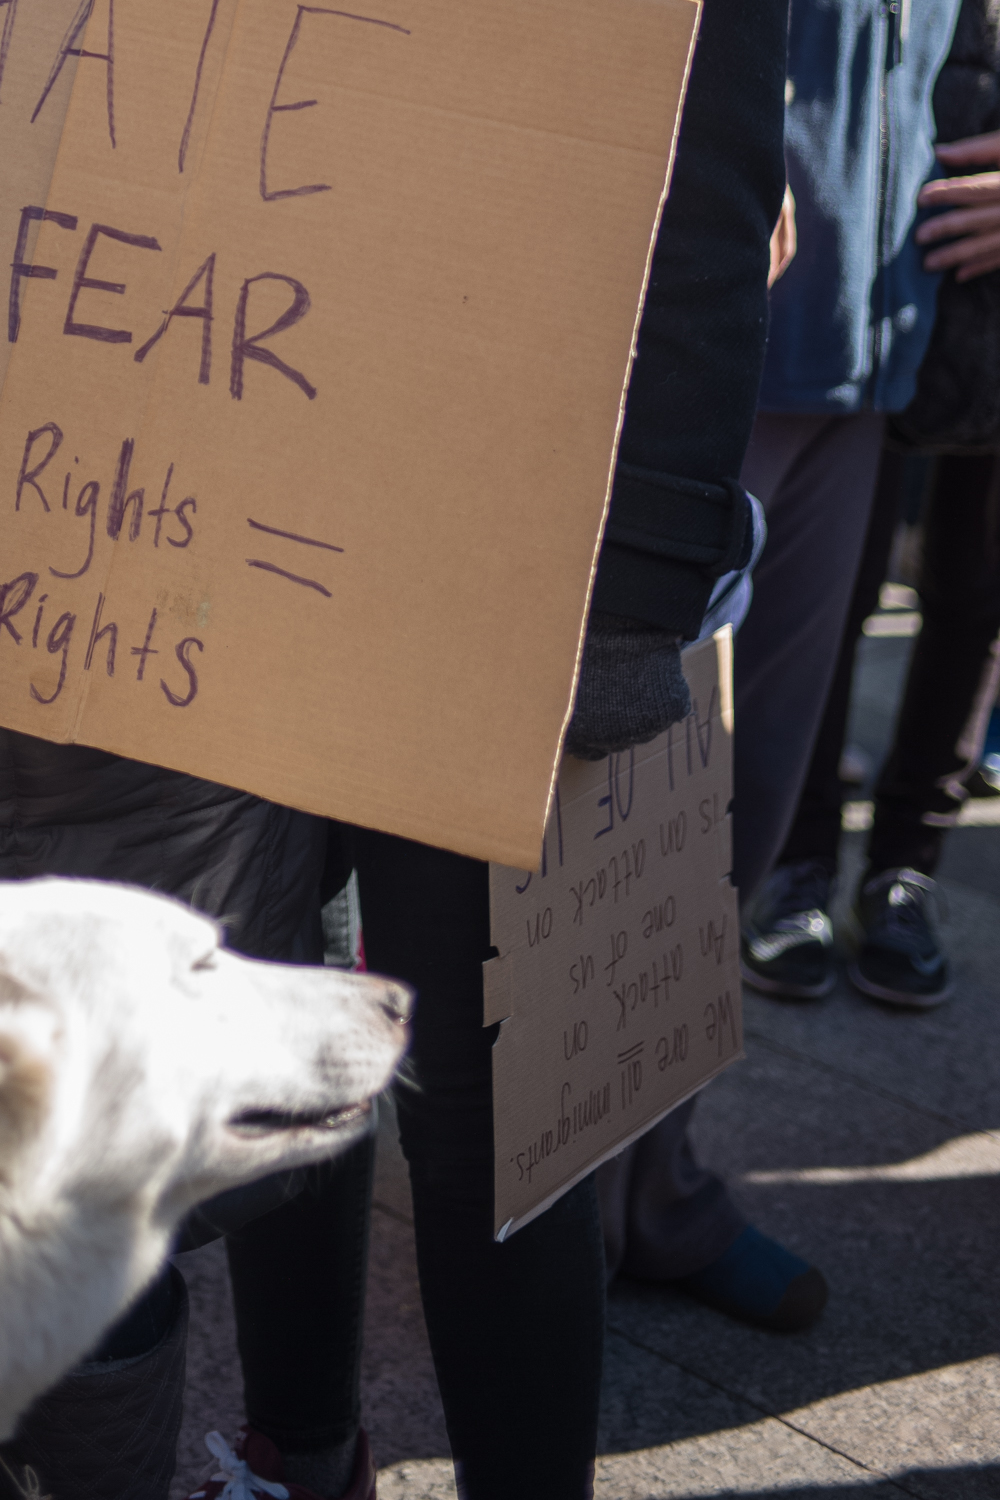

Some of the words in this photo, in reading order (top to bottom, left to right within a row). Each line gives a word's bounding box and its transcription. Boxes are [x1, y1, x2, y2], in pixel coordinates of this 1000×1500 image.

[9, 205, 317, 400] FEAR
[15, 422, 198, 579] Rights
[659, 810, 688, 857] an
[569, 838, 647, 927] attack
[526, 907, 553, 948] on
[641, 895, 677, 939] one
[699, 913, 728, 966] An
[569, 954, 595, 994] us
[604, 930, 628, 987] of
[613, 943, 684, 1032] attack
[563, 1020, 589, 1061] on
[655, 1023, 690, 1072] are
[703, 990, 739, 1057] We
[620, 1060, 643, 1110] all
[510, 1081, 611, 1184] immigrants.
